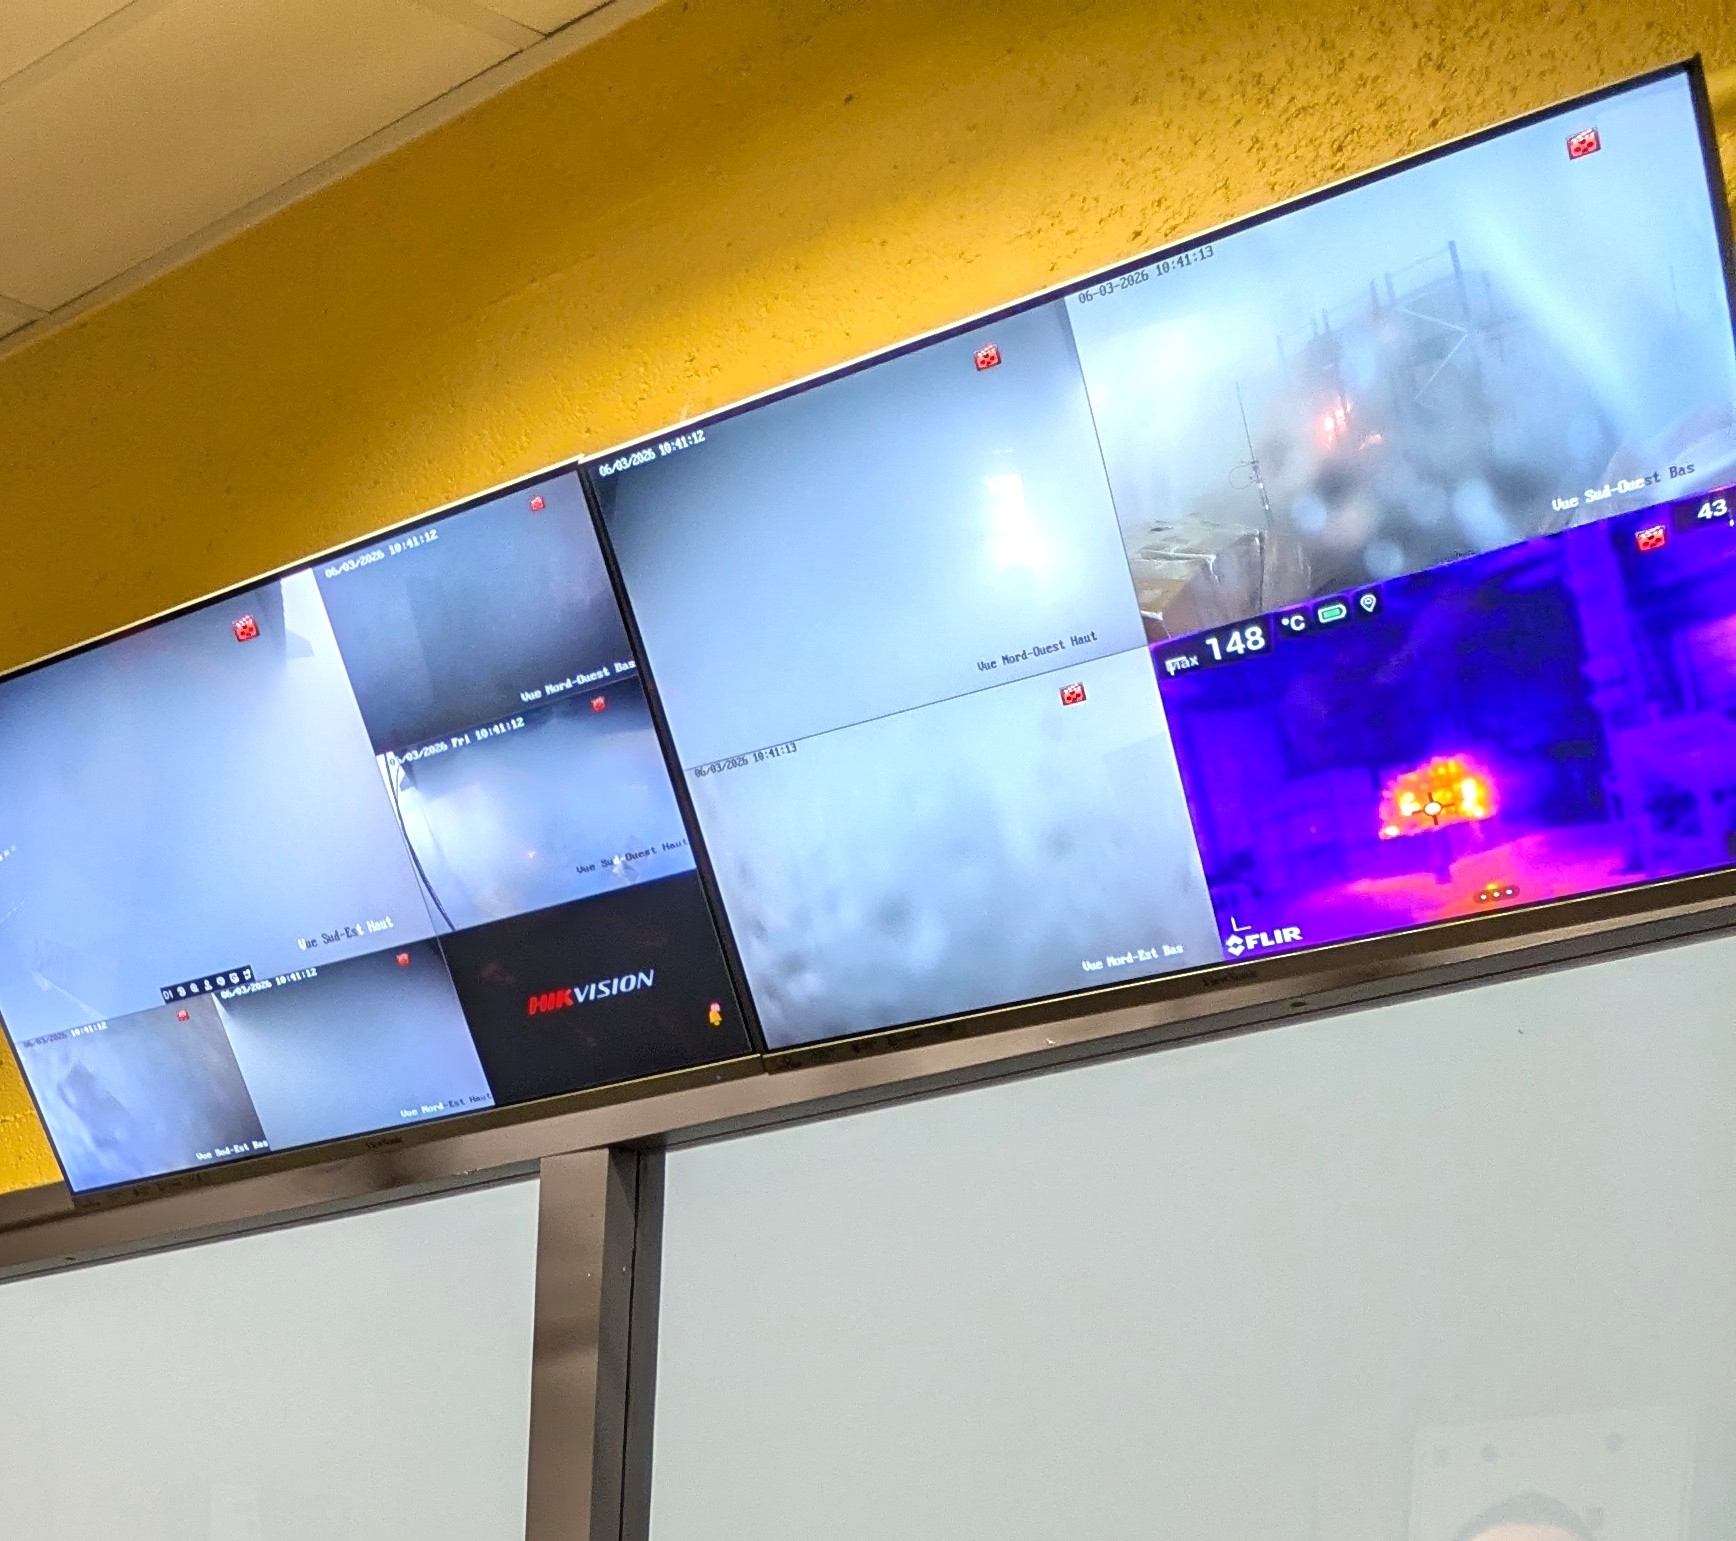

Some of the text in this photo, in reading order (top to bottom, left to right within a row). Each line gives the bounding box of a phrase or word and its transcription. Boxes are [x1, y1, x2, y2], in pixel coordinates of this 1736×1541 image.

[1079, 245, 1214, 304] 06-03-2026 10:41:13
[599, 430, 705, 477] 06/03/2026 10:41:12
[1668, 463, 1695, 479] Bas
[1698, 499, 1727, 520] 43
[325, 529, 438, 578] 06/03/2026 10:41:12
[1070, 631, 1098, 648] Haut
[1206, 626, 1265, 660] 148
[1281, 615, 1305, 632] °C
[452, 735, 471, 748] Fri
[476, 717, 525, 741] 10:41:12
[694, 742, 797, 778] 06/03/2026 10:41:13
[366, 917, 394, 934] Haut
[1245, 926, 1303, 950] FLIR
[1162, 945, 1184, 956] Bas
[275, 968, 317, 988] 10:41:12
[528, 969, 655, 1016] HIKVISION
